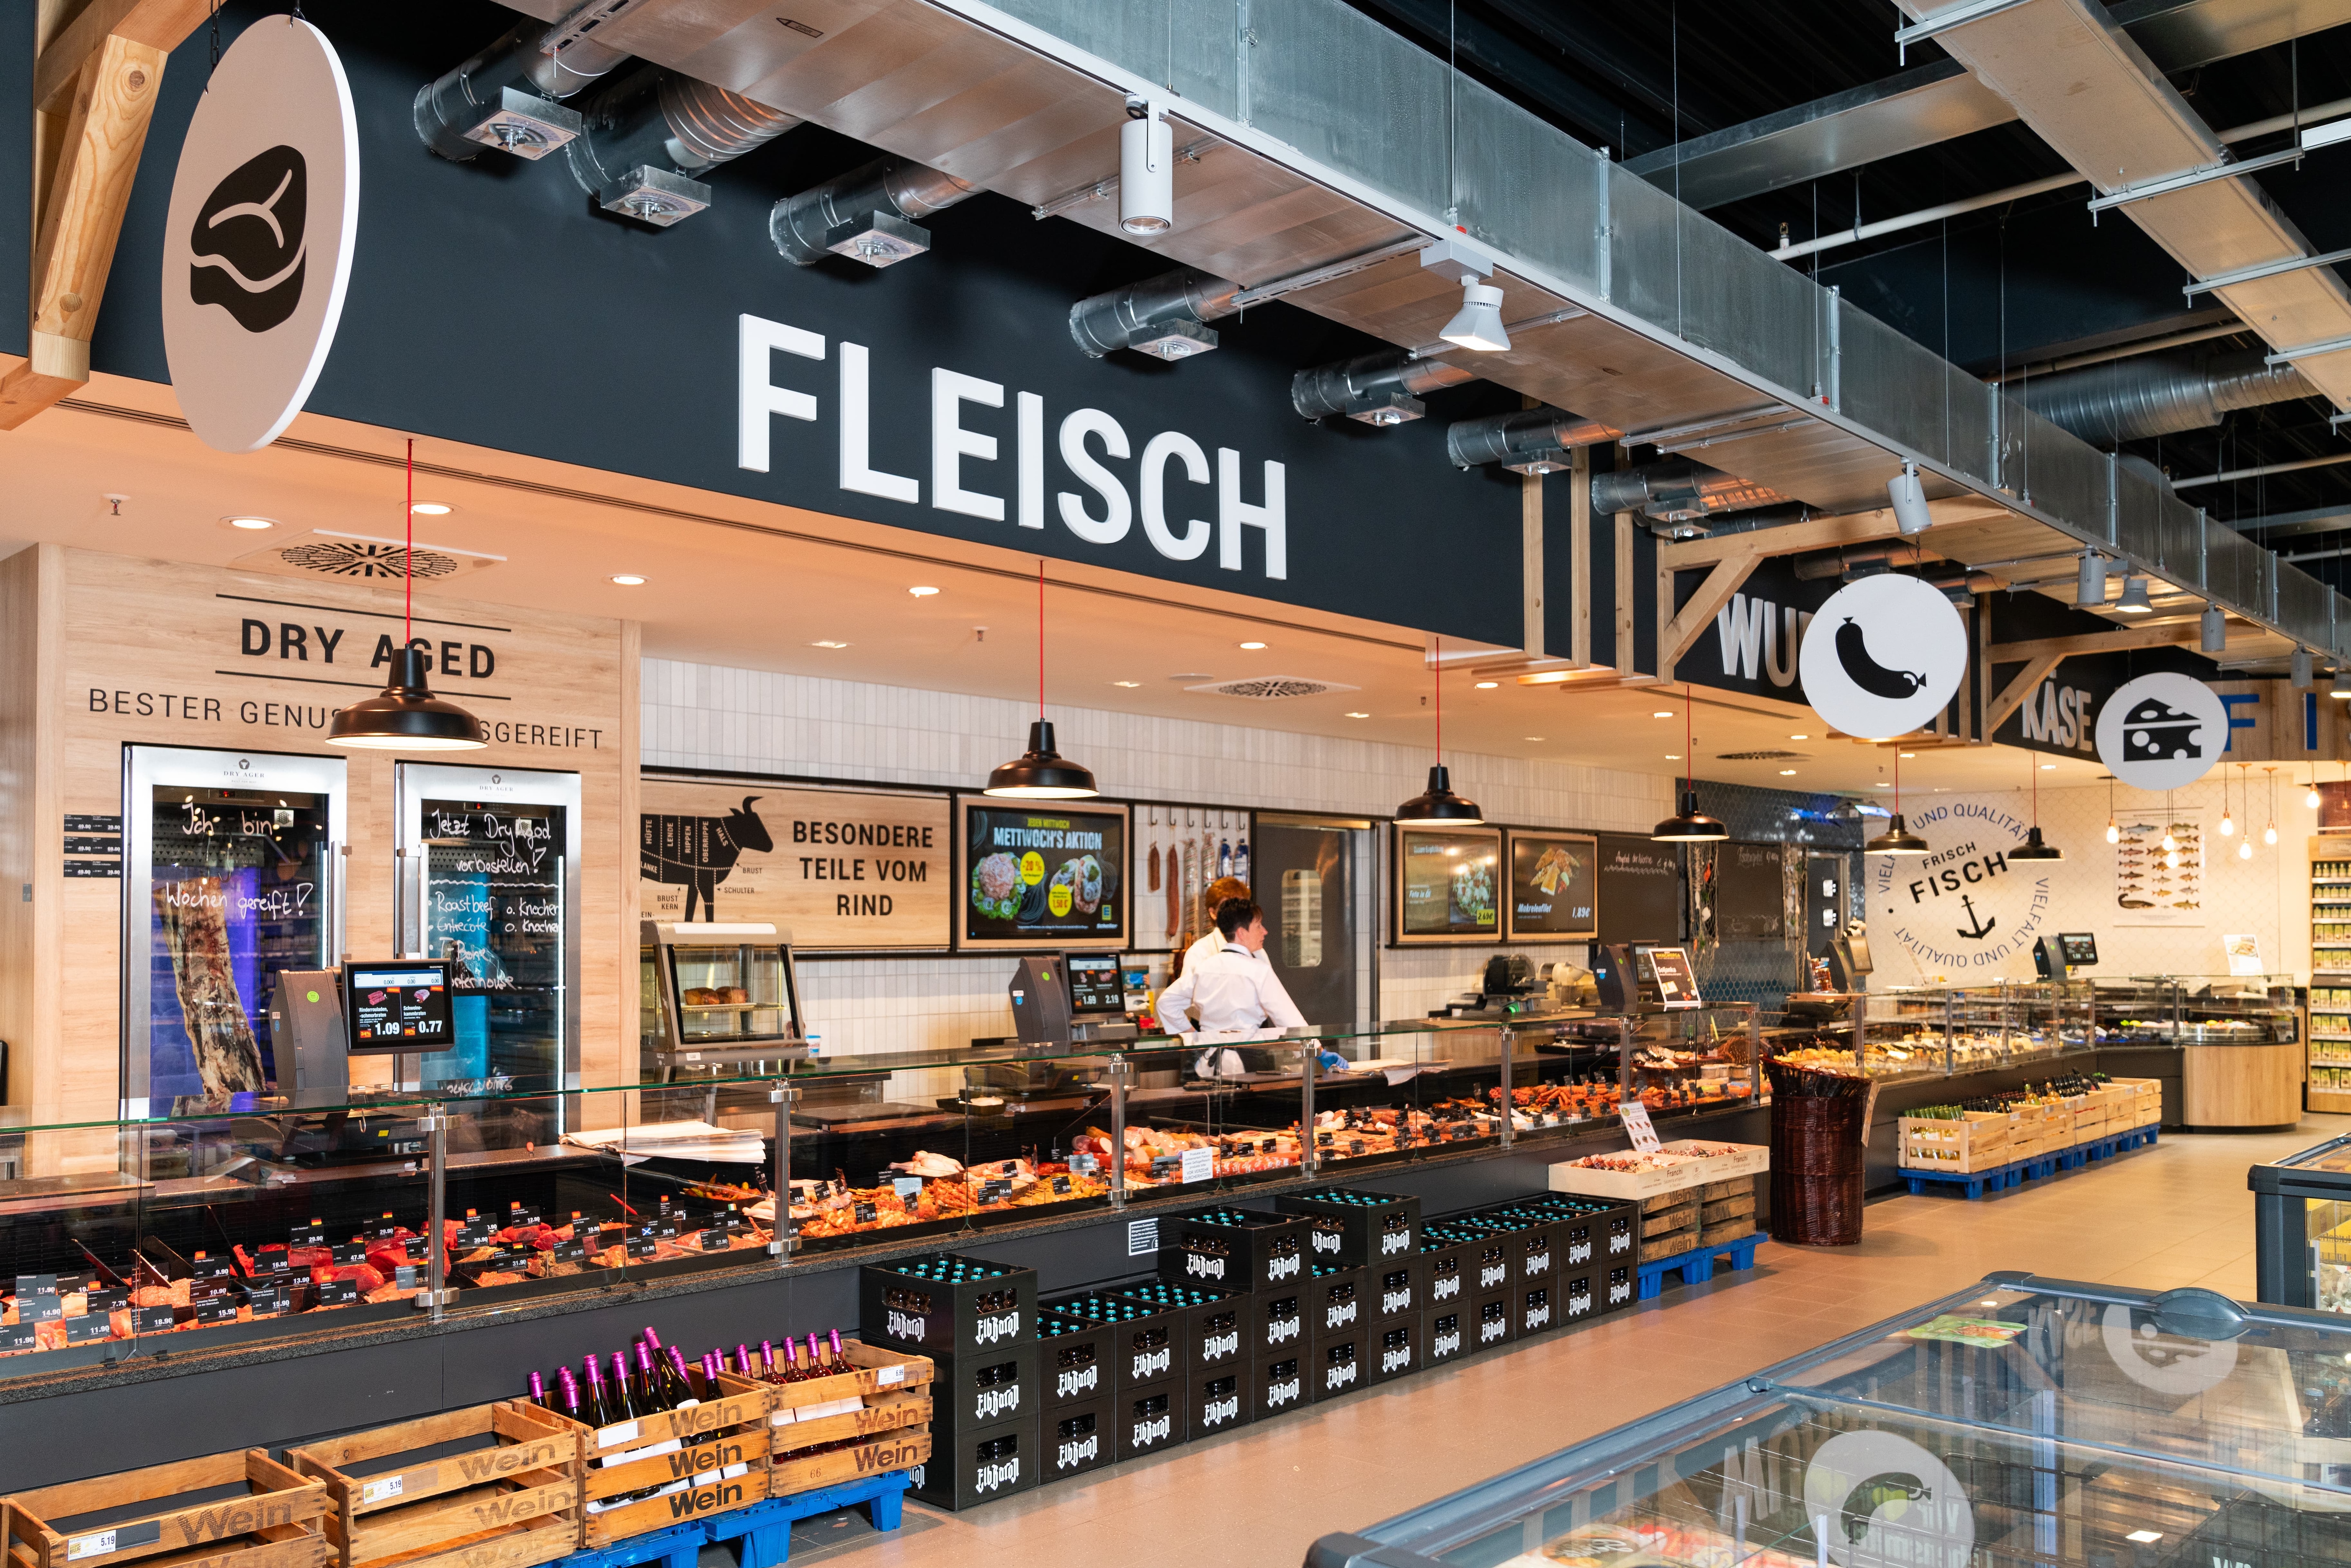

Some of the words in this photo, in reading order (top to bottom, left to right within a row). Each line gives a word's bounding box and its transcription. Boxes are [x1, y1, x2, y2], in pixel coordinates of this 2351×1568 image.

[739, 313, 1286, 580] FLEISCH
[242, 619, 345, 663] DRY
[90, 688, 221, 721] BESTER
[241, 701, 342, 729] GENU
[481, 720, 602, 749] SGEREIFT
[2022, 670, 2092, 752] KÄSE
[242, 811, 273, 835] bin
[430, 808, 470, 840] Jetzt
[794, 820, 933, 848] BESONDERE
[1913, 806, 1947, 829] UND
[1954, 804, 2029, 841] QUALITÄT
[716, 827, 728, 846] HALS
[1065, 831, 1102, 850] AKTION
[1922, 841, 1976, 869] FRISCH
[640, 861, 658, 874] LANKE
[800, 858, 865, 880] TEILE
[876, 859, 927, 882] VOM
[1909, 851, 2008, 903] FISCH
[166, 882, 228, 907] Wochen
[435, 891, 496, 920] Roastbeef
[837, 894, 892, 916] RIND
[2012, 877, 2049, 948] VIELFALT
[1894, 928, 1967, 967] QUALITÄT
[1974, 945, 2010, 965] UND
[451, 976, 517, 990] orterhouse
[375, 1022, 400, 1035] 1.09
[418, 1020, 442, 1033] 0.77
[1733, 1154, 1748, 1163] Franchi
[1667, 1167, 1683, 1177] Franchi
[1669, 1190, 1691, 1205] Wein
[1669, 1213, 1691, 1229] Wein
[1312, 1231, 1341, 1254] bBaron
[1669, 1236, 1691, 1253] Wein
[14, 1336, 34, 1345] 11.90
[90, 1325, 110, 1333] 11.90
[669, 1403, 742, 1437] Wein
[854, 1404, 918, 1435] Wein
[458, 1443, 555, 1481] Wein
[668, 1443, 742, 1478] Wein
[853, 1441, 917, 1472] Wein
[390, 1480, 402, 1490] 5.19
[810, 1468, 821, 1479] 66
[474, 1489, 571, 1526] Wein
[669, 1483, 742, 1519] Wein
[176, 1502, 291, 1545] Wein
[70, 1545, 81, 1555] BILLIG
[101, 1535, 115, 1546] 5.19
